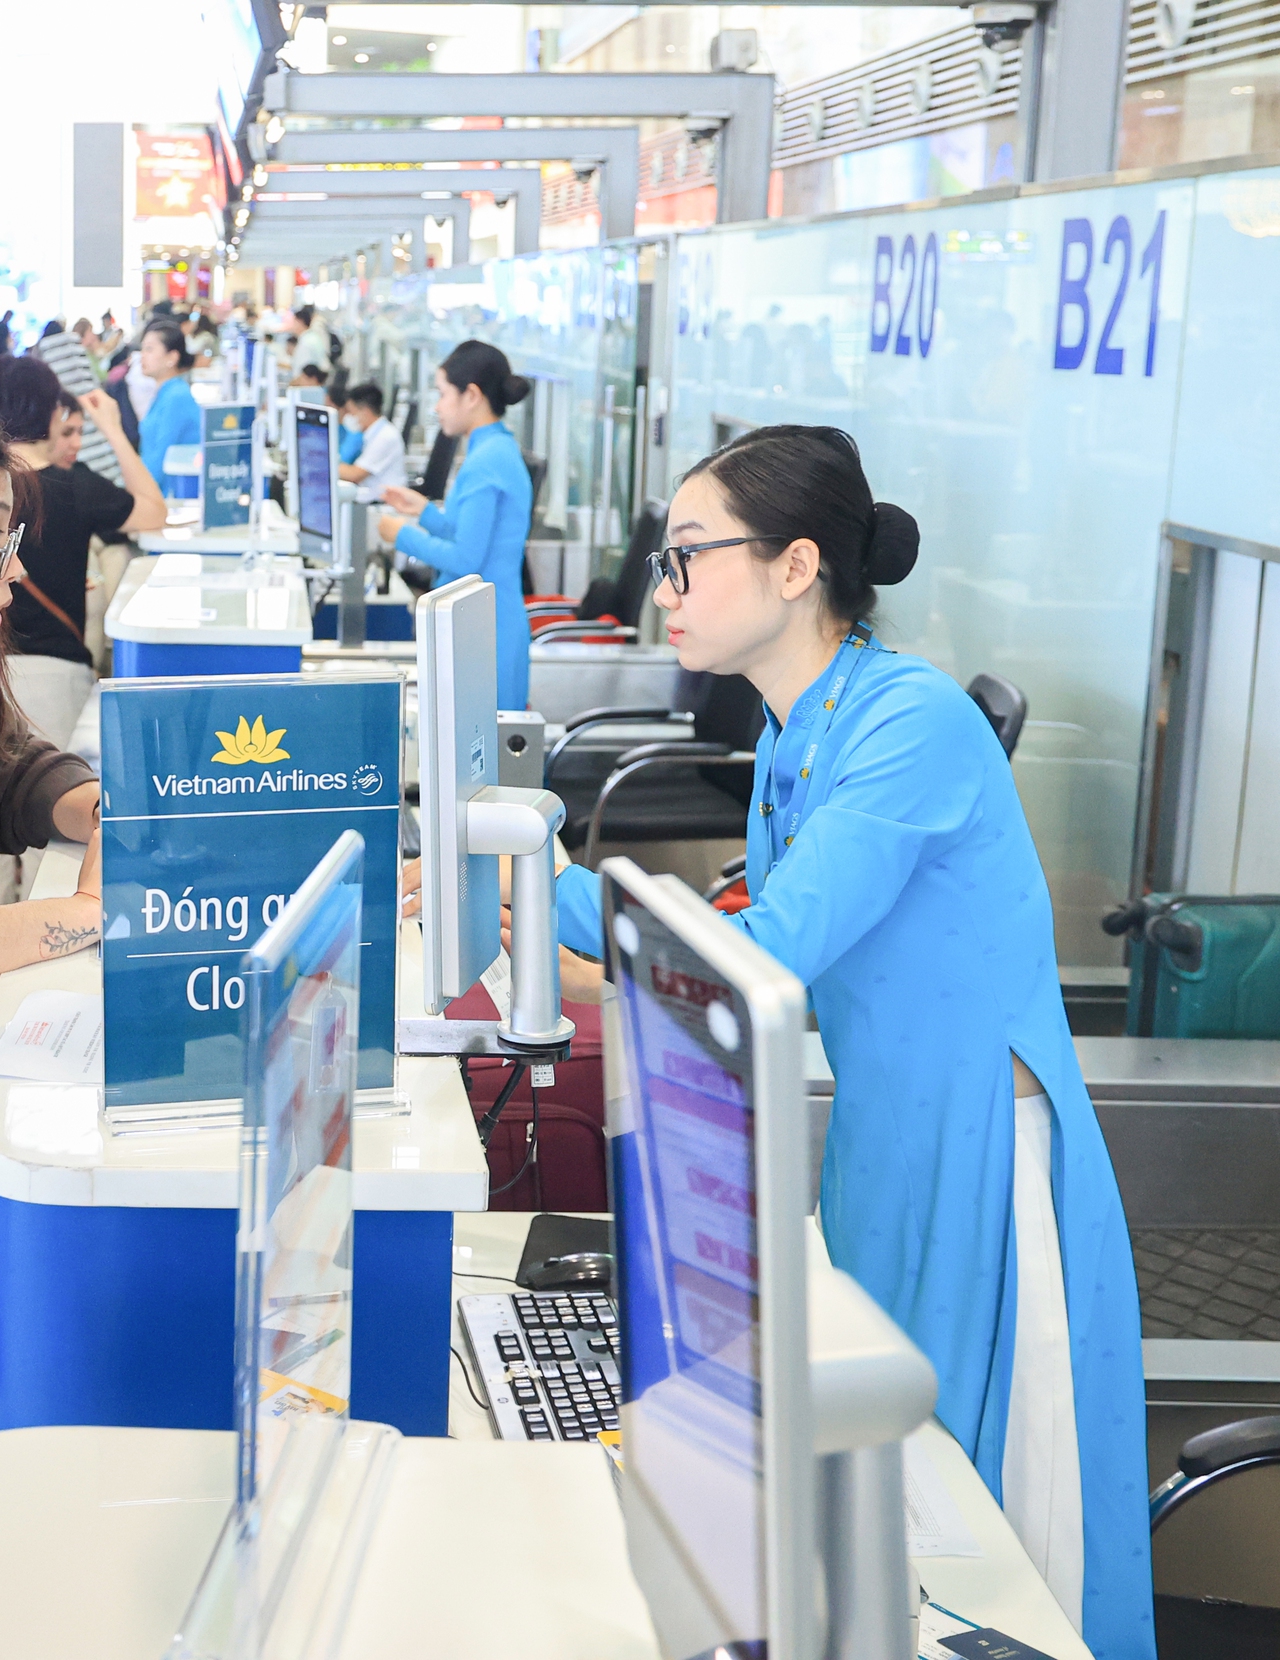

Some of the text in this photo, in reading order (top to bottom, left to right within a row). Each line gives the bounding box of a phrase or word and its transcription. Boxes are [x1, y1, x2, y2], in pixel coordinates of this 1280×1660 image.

[871, 231, 937, 358] B20
[1054, 210, 1167, 376] B21
[152, 769, 347, 797] Vietnam Airlines
[141, 886, 249, 941] Đóng
[186, 965, 245, 1011] Clo
